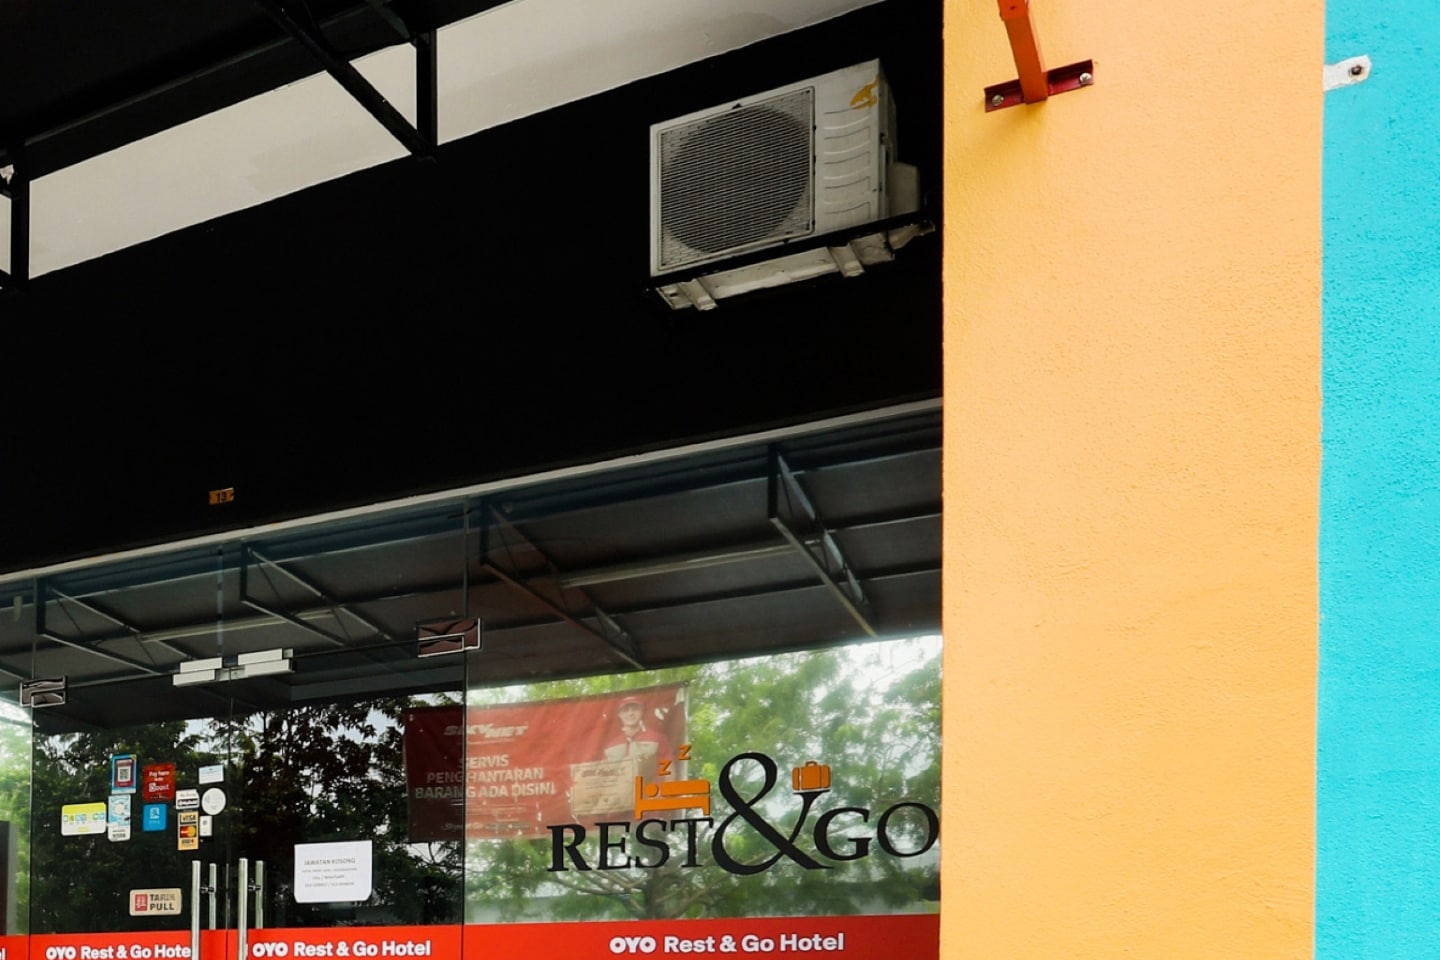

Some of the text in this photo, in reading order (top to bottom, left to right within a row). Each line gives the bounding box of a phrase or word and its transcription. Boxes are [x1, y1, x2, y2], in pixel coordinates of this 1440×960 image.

[150, 903, 175, 911] PULL
[252, 940, 431, 958] OYO Rest & Go Hotel
[609, 932, 845, 954] OYO Rest & Go Hotel
[46, 944, 192, 960] OYO Rest & Go Hote
